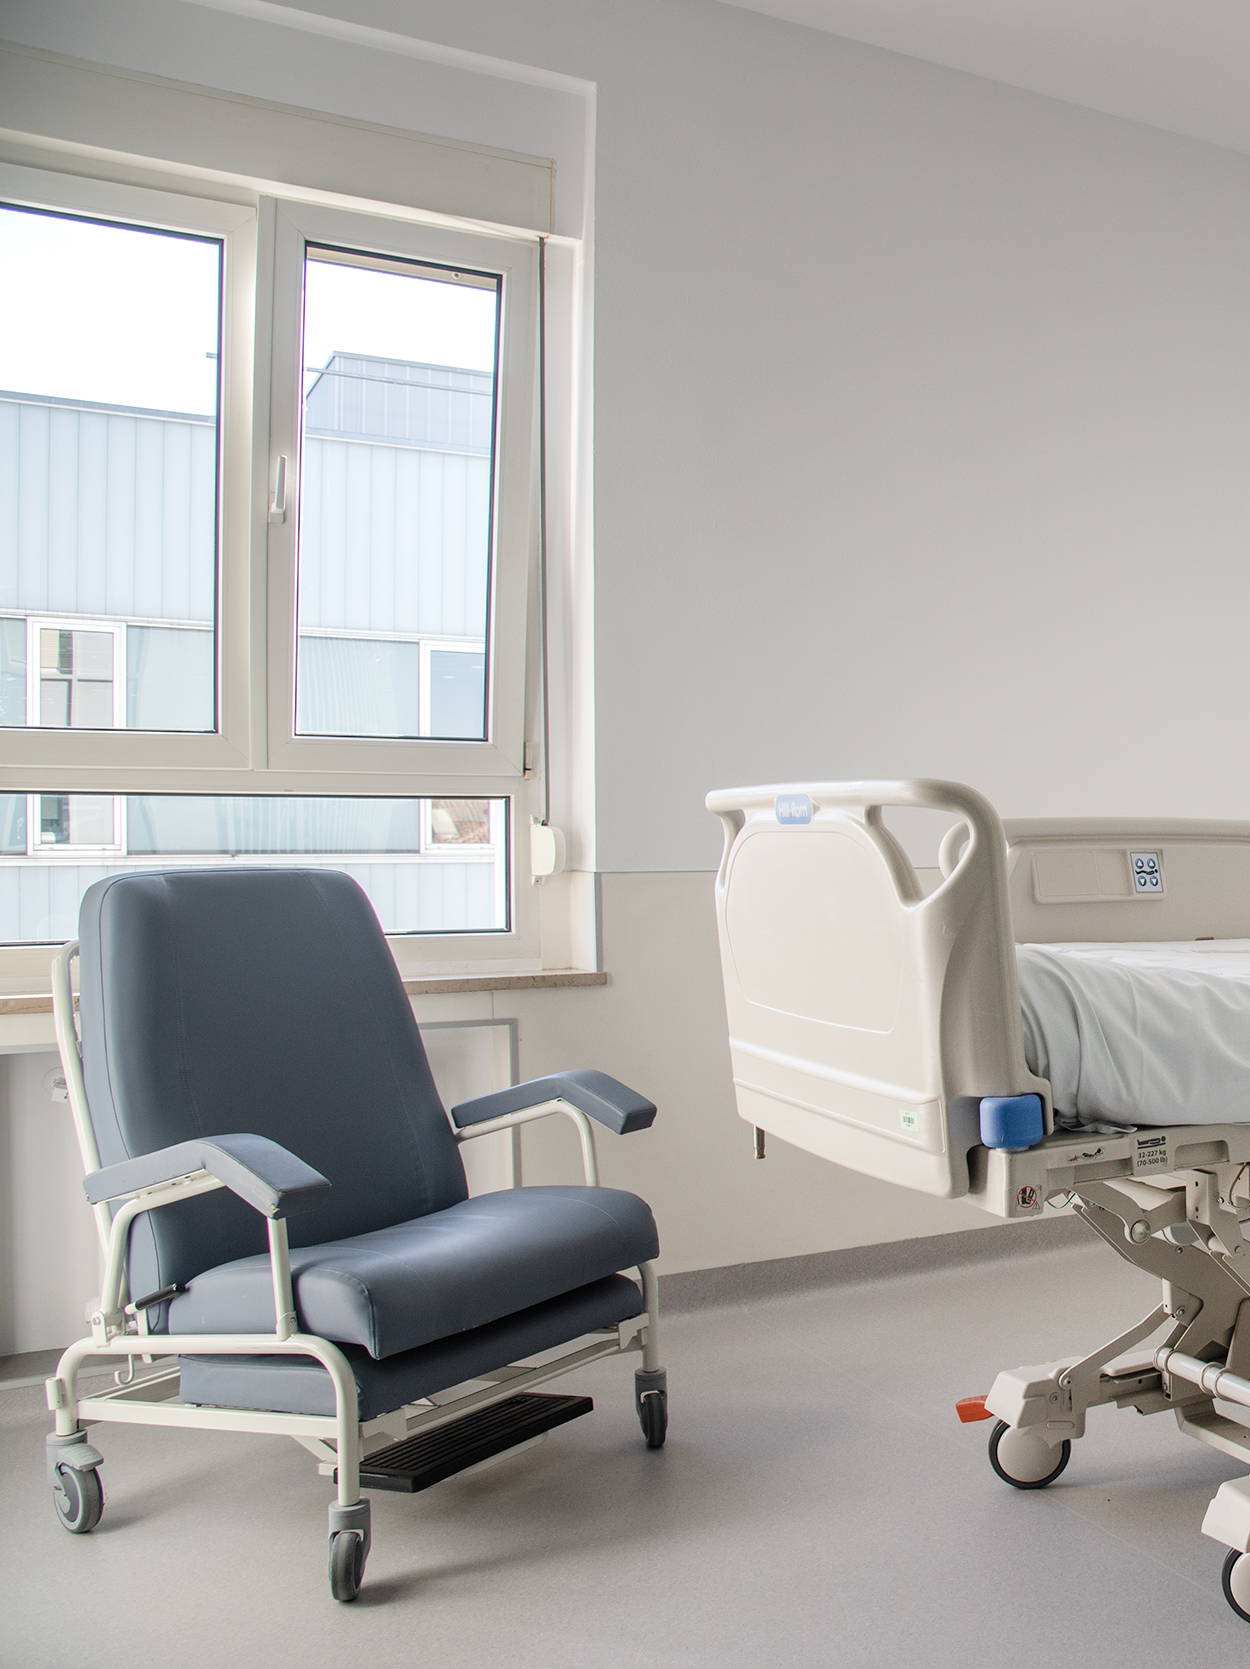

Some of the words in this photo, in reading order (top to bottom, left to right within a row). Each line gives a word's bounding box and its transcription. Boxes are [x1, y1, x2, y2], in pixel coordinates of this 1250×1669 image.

[778, 801, 809, 818] Hill-Rom
[1138, 1150, 1158, 1159] 32-227
[1158, 1149, 1167, 1157] kg
[1136, 1157, 1160, 1168] (70-500
[1159, 1155, 1169, 1164] lb)
